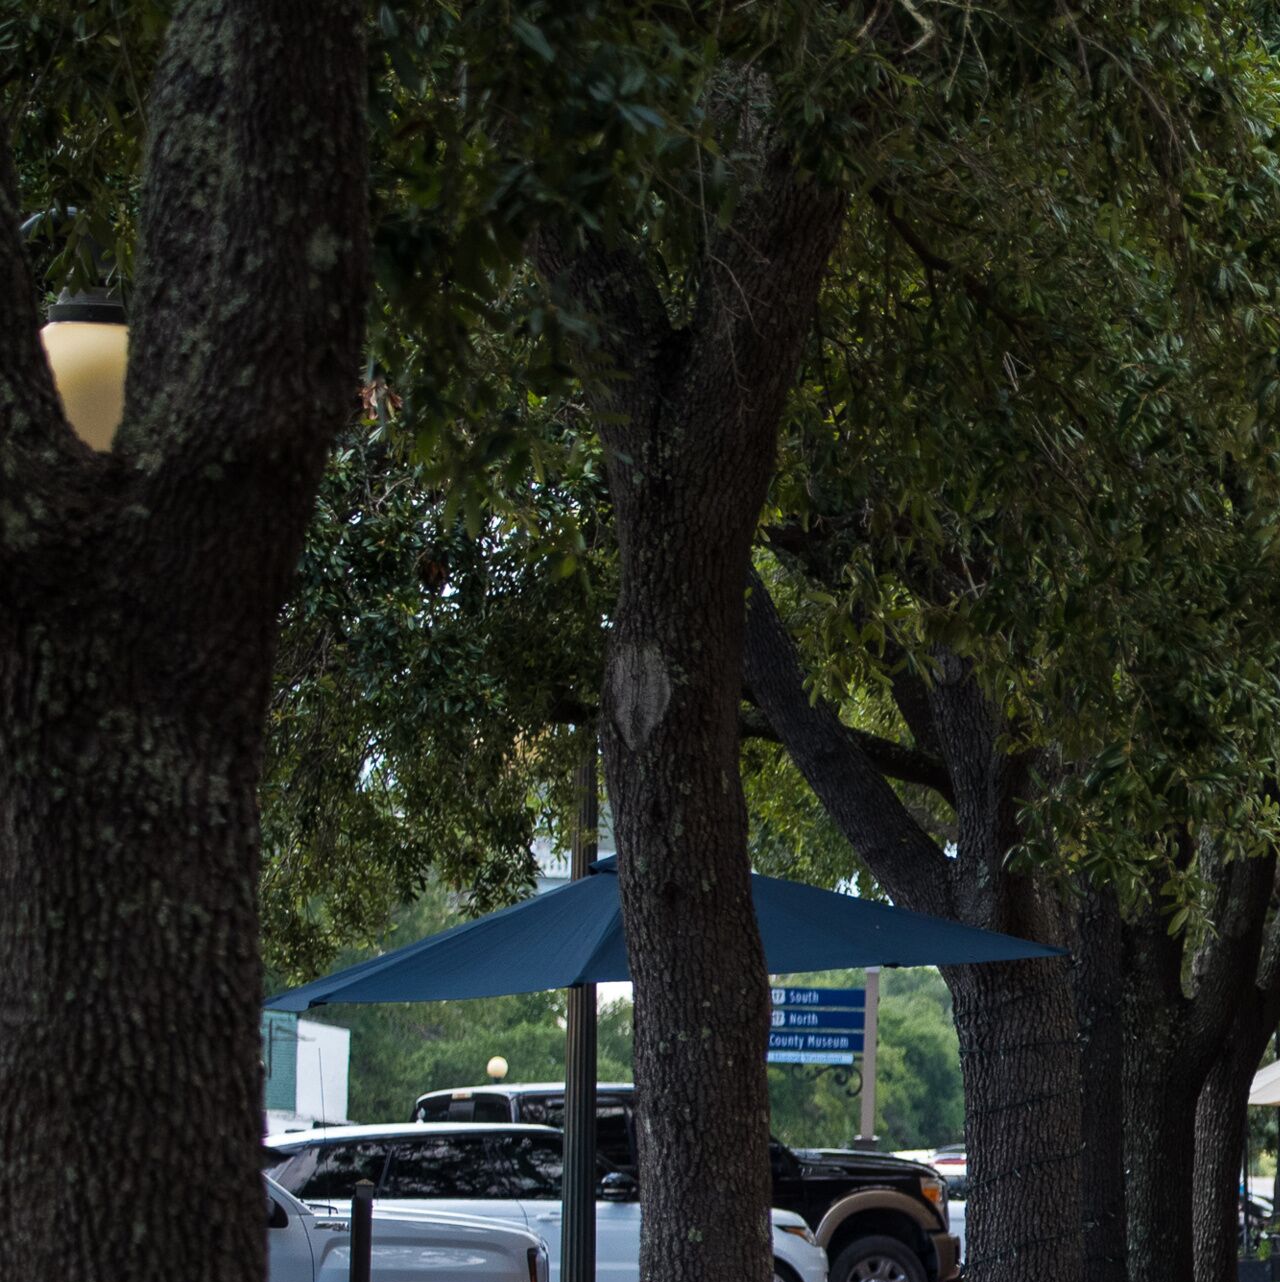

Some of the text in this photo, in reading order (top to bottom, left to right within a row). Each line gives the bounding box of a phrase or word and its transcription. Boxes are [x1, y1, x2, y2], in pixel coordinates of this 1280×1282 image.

[789, 990, 819, 1003] South
[789, 1013, 818, 1026] North
[768, 1033, 849, 1050] County Museum
